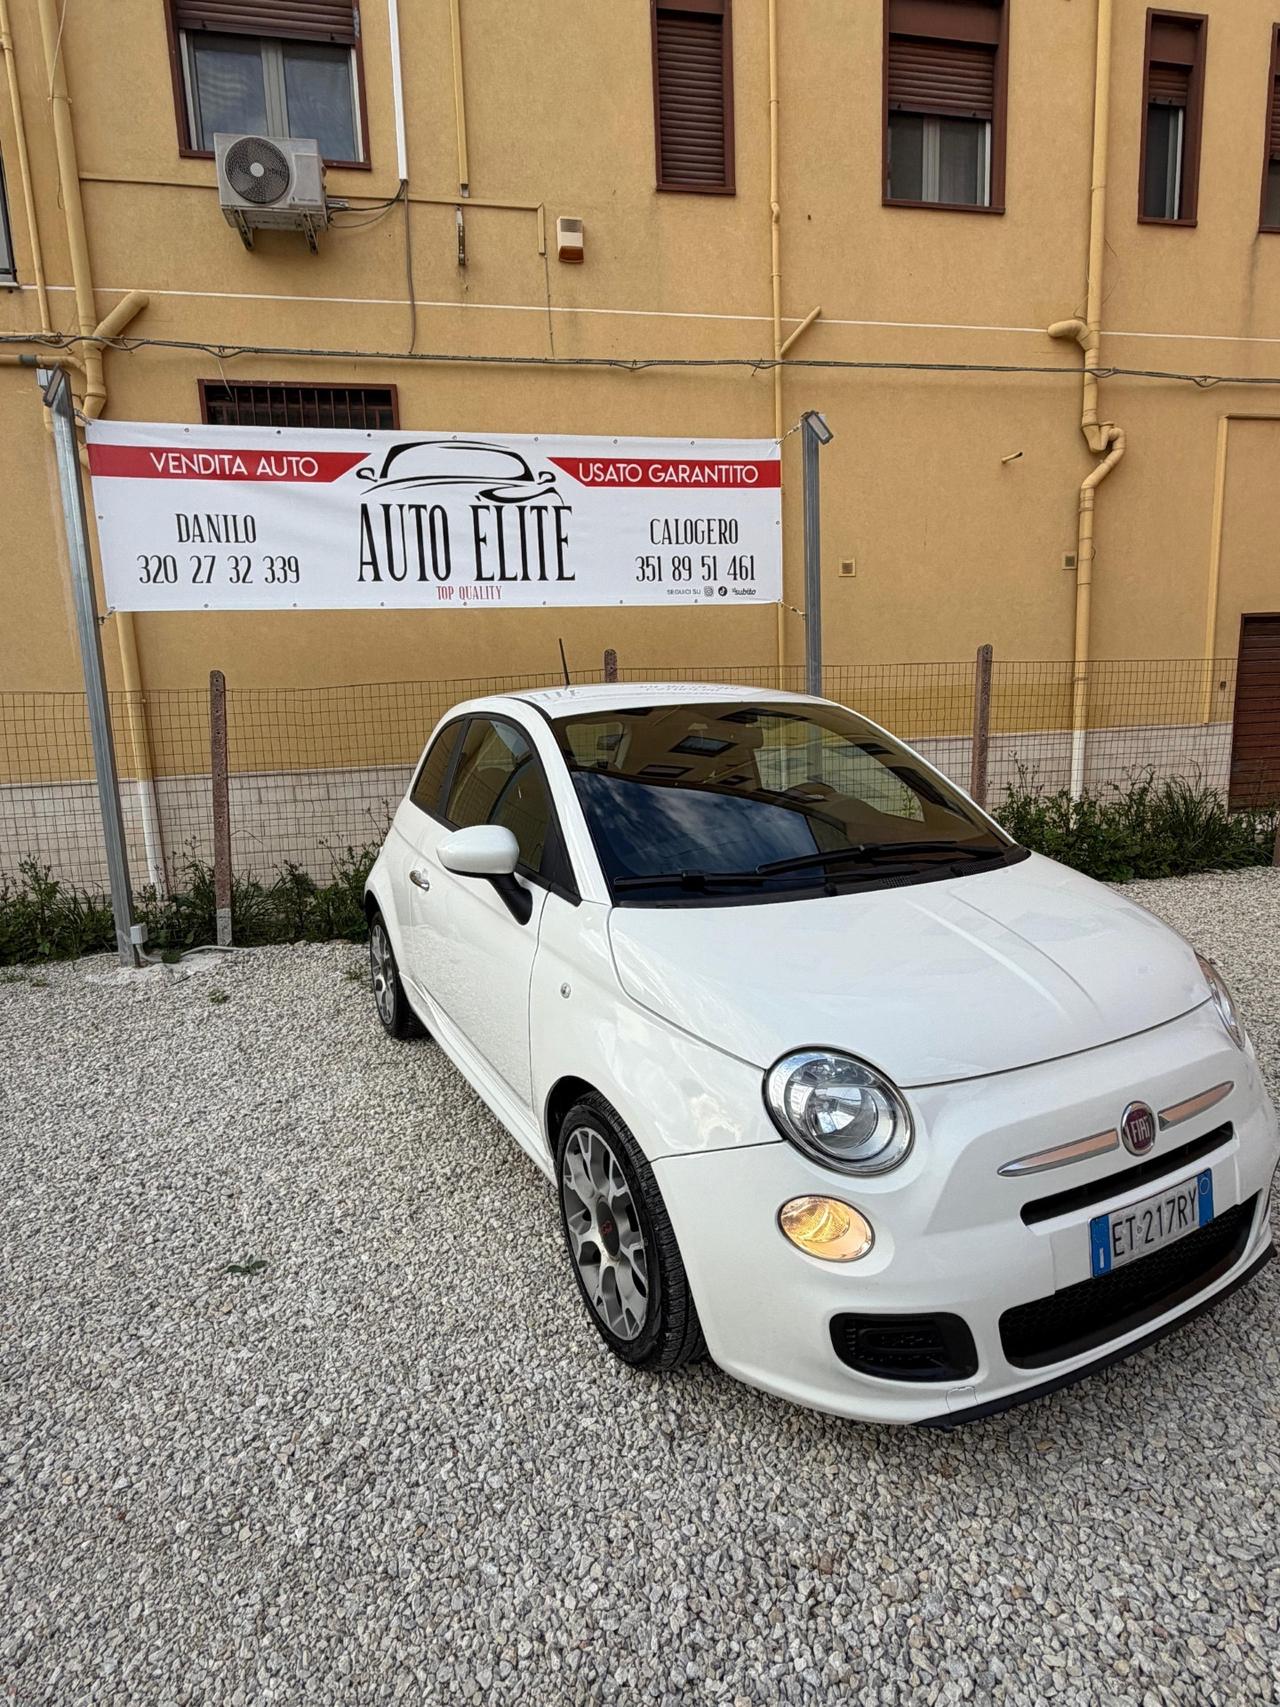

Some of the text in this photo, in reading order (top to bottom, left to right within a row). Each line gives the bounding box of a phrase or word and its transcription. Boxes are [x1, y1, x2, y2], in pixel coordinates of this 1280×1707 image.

[150, 452, 319, 477] VENDITA AUTO
[578, 462, 759, 484] USATO GARANTITO
[175, 513, 257, 544] DANILO
[649, 518, 739, 545] CALOGERO
[357, 503, 452, 582] AUTO
[136, 555, 300, 584] 320 27 32 339
[635, 555, 756, 582] 351 89 51 461
[436, 585, 502, 600] TOP QUALITY
[1130, 1116, 1151, 1143] FIAT
